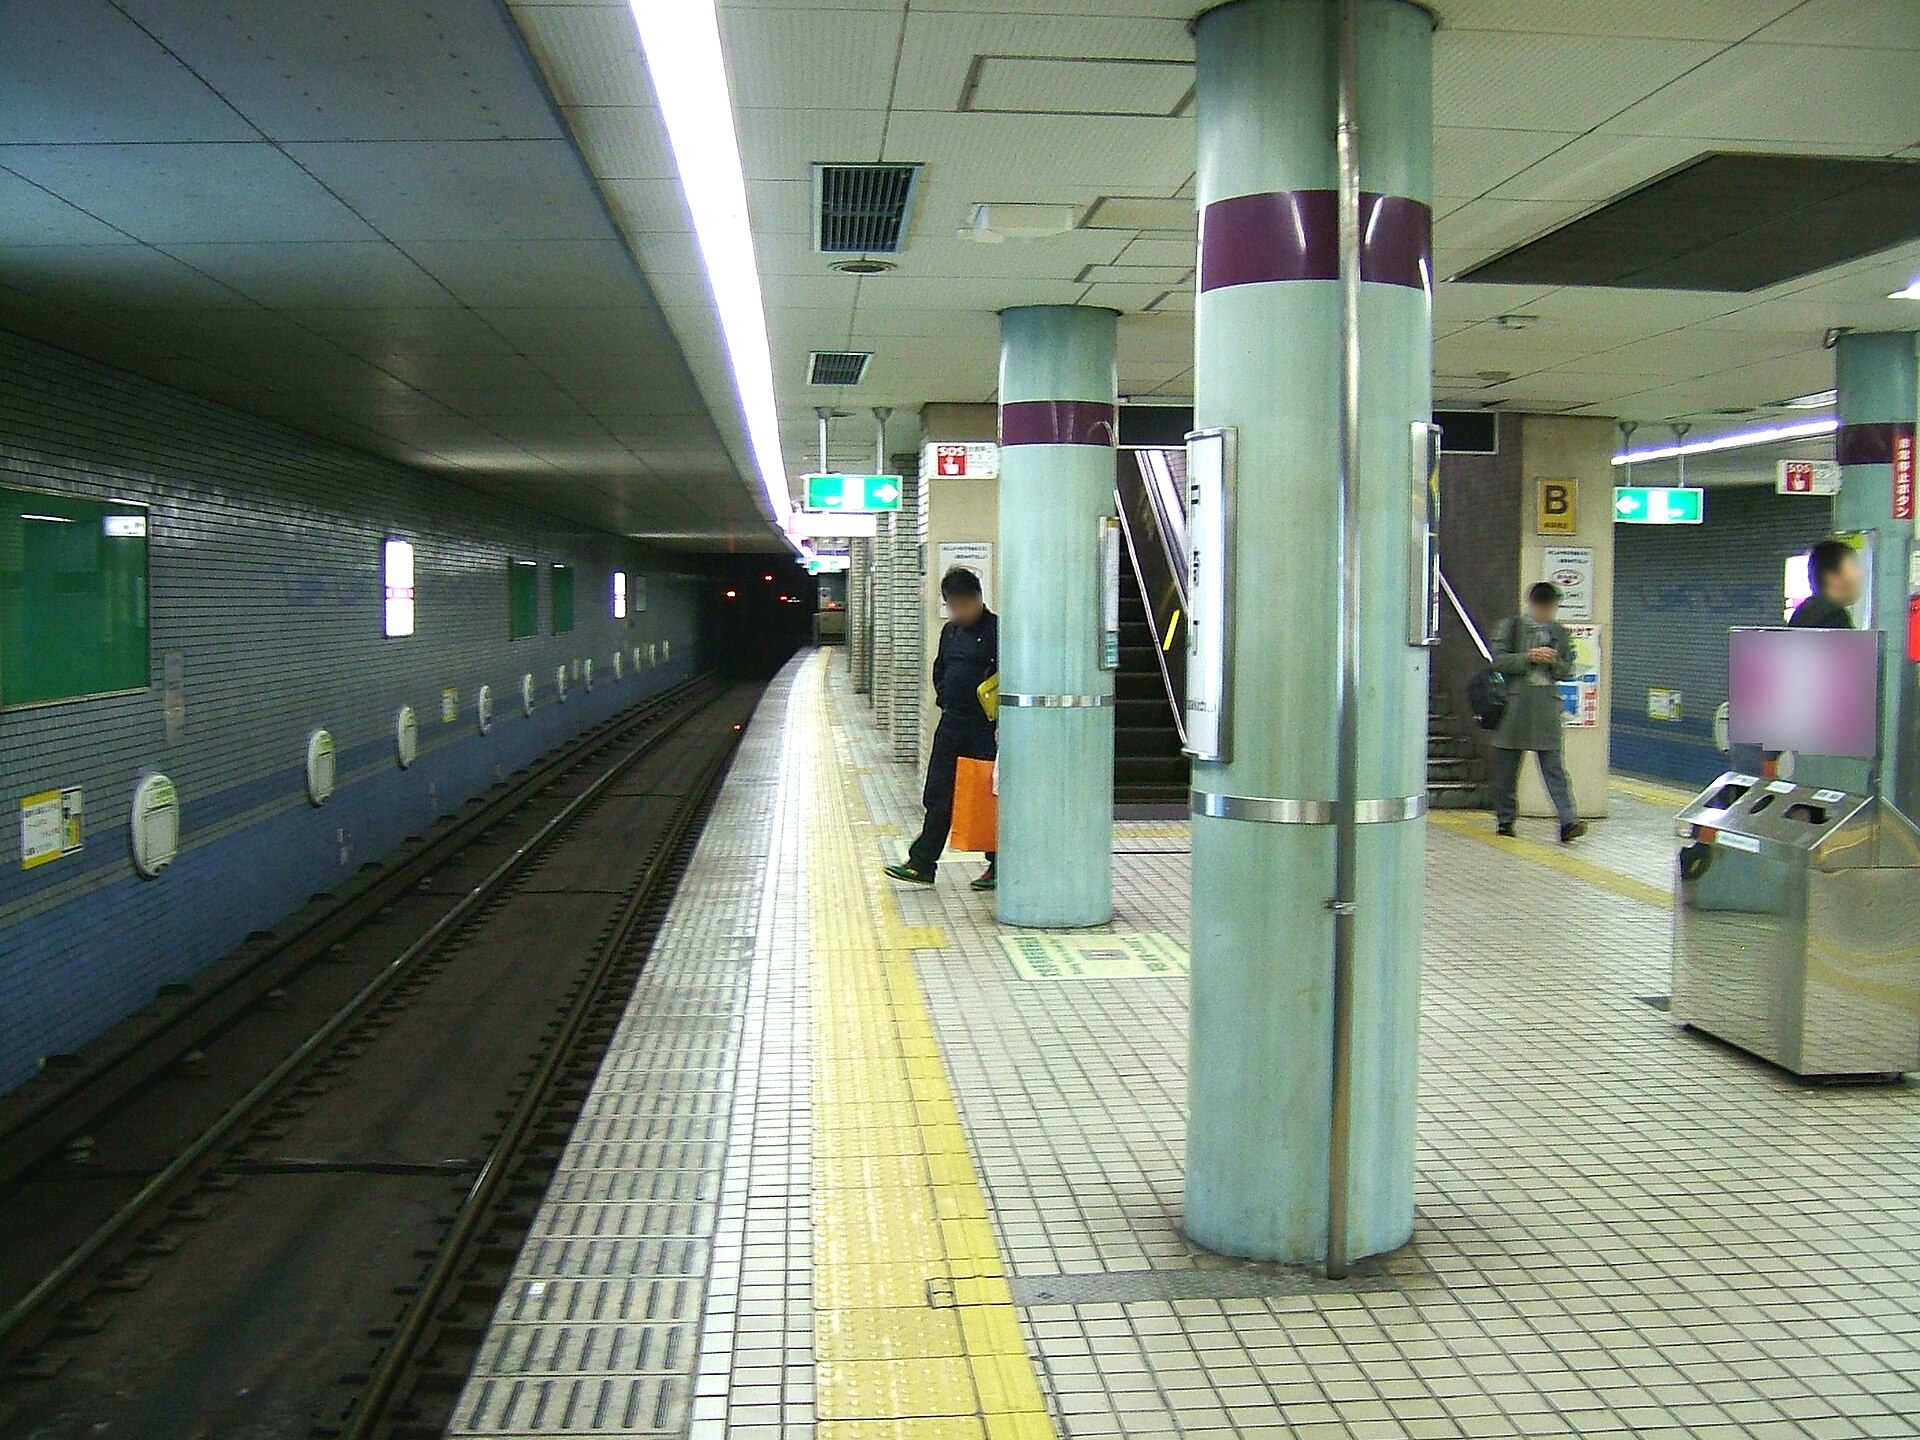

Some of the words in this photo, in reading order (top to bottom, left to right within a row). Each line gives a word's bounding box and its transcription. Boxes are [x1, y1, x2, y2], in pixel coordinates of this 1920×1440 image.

[938, 446, 965, 457] SOS
[1788, 463, 1811, 473] SOS
[1545, 485, 1568, 514] B
